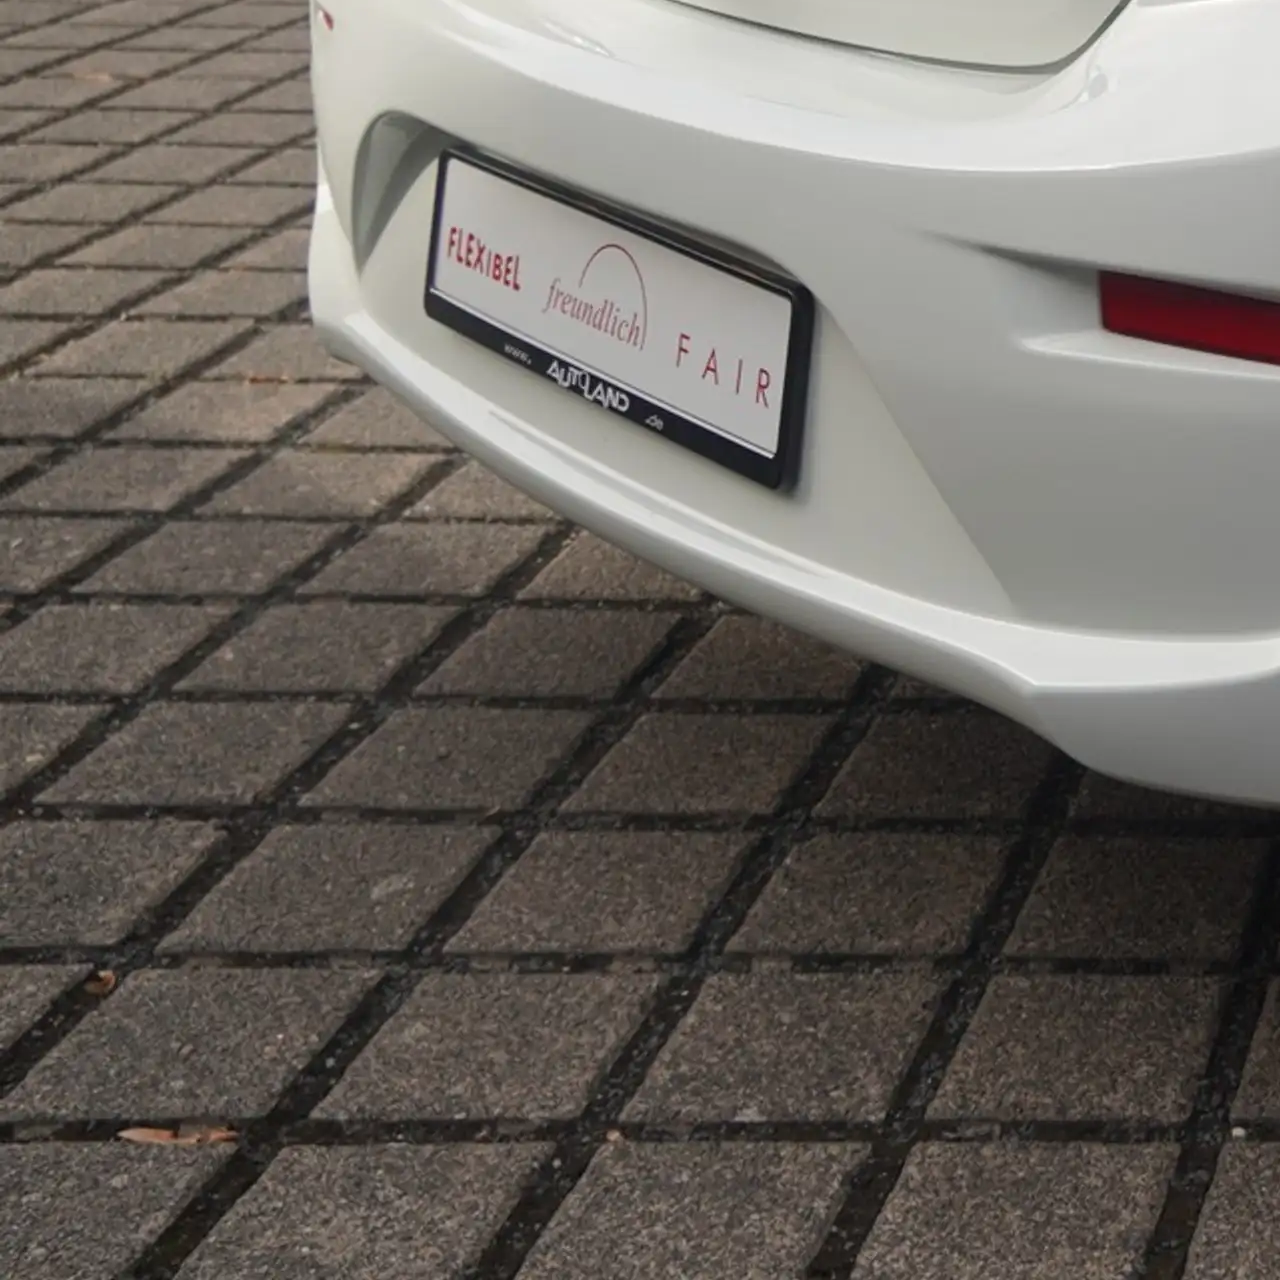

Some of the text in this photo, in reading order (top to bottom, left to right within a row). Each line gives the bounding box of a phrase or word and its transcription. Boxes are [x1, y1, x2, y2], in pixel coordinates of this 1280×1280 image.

[447, 226, 770, 409] FLEXIBEL freundlich FAIR
[546, 359, 630, 412] AUTOLAND
